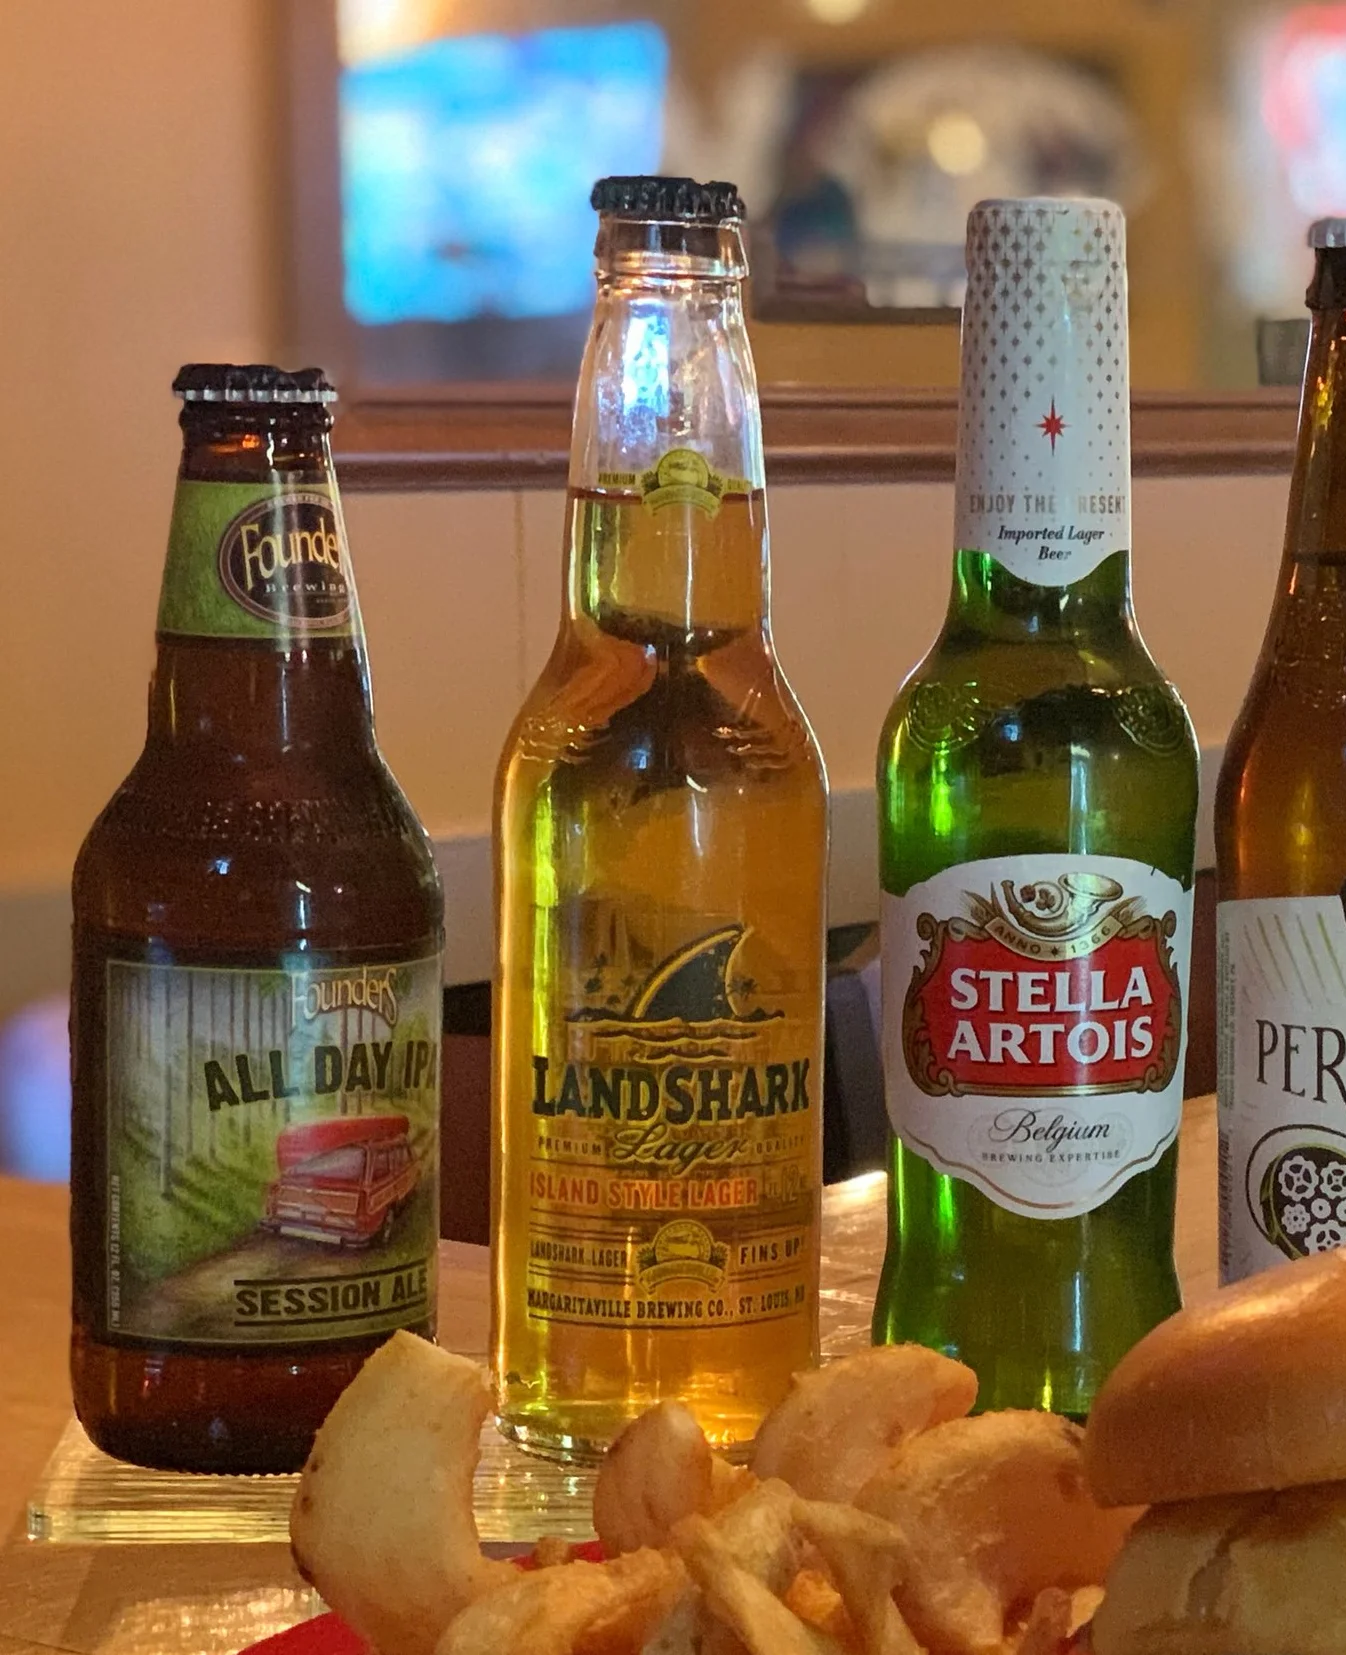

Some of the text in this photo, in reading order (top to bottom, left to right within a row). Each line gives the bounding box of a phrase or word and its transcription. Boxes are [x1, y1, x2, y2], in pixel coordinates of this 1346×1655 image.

[969, 494, 1015, 514] ENJOY
[1024, 494, 1057, 514] THE
[997, 525, 1105, 545] Imported Lager
[240, 517, 342, 591] Founde
[1038, 546, 1072, 562] Beer
[994, 925, 1112, 954] ANNO 1366
[291, 966, 397, 1027] Founders
[949, 966, 1154, 1014] STELLA
[946, 1016, 1154, 1066] ARTOIS
[204, 1050, 299, 1111] ALL
[314, 1041, 393, 1095] DAY
[532, 1056, 810, 1124] LANDSHARK
[537, 1135, 806, 1156] PREMIUM QUALITY
[613, 1122, 749, 1177] Lager
[992, 1108, 1110, 1154] Belgium
[981, 1149, 1121, 1163] BREWING EXPERTISE
[530, 1171, 599, 1205] ISLAND
[608, 1180, 681, 1208] STYLE
[688, 1178, 758, 1208] LAGER
[530, 1240, 628, 1268] LANDSHARK LAGER
[740, 1242, 779, 1265] FINS
[236, 1266, 427, 1318] SESSION ALE
[528, 1288, 631, 1318] MARGARITAVILLE
[636, 1299, 702, 1320] BREWING
